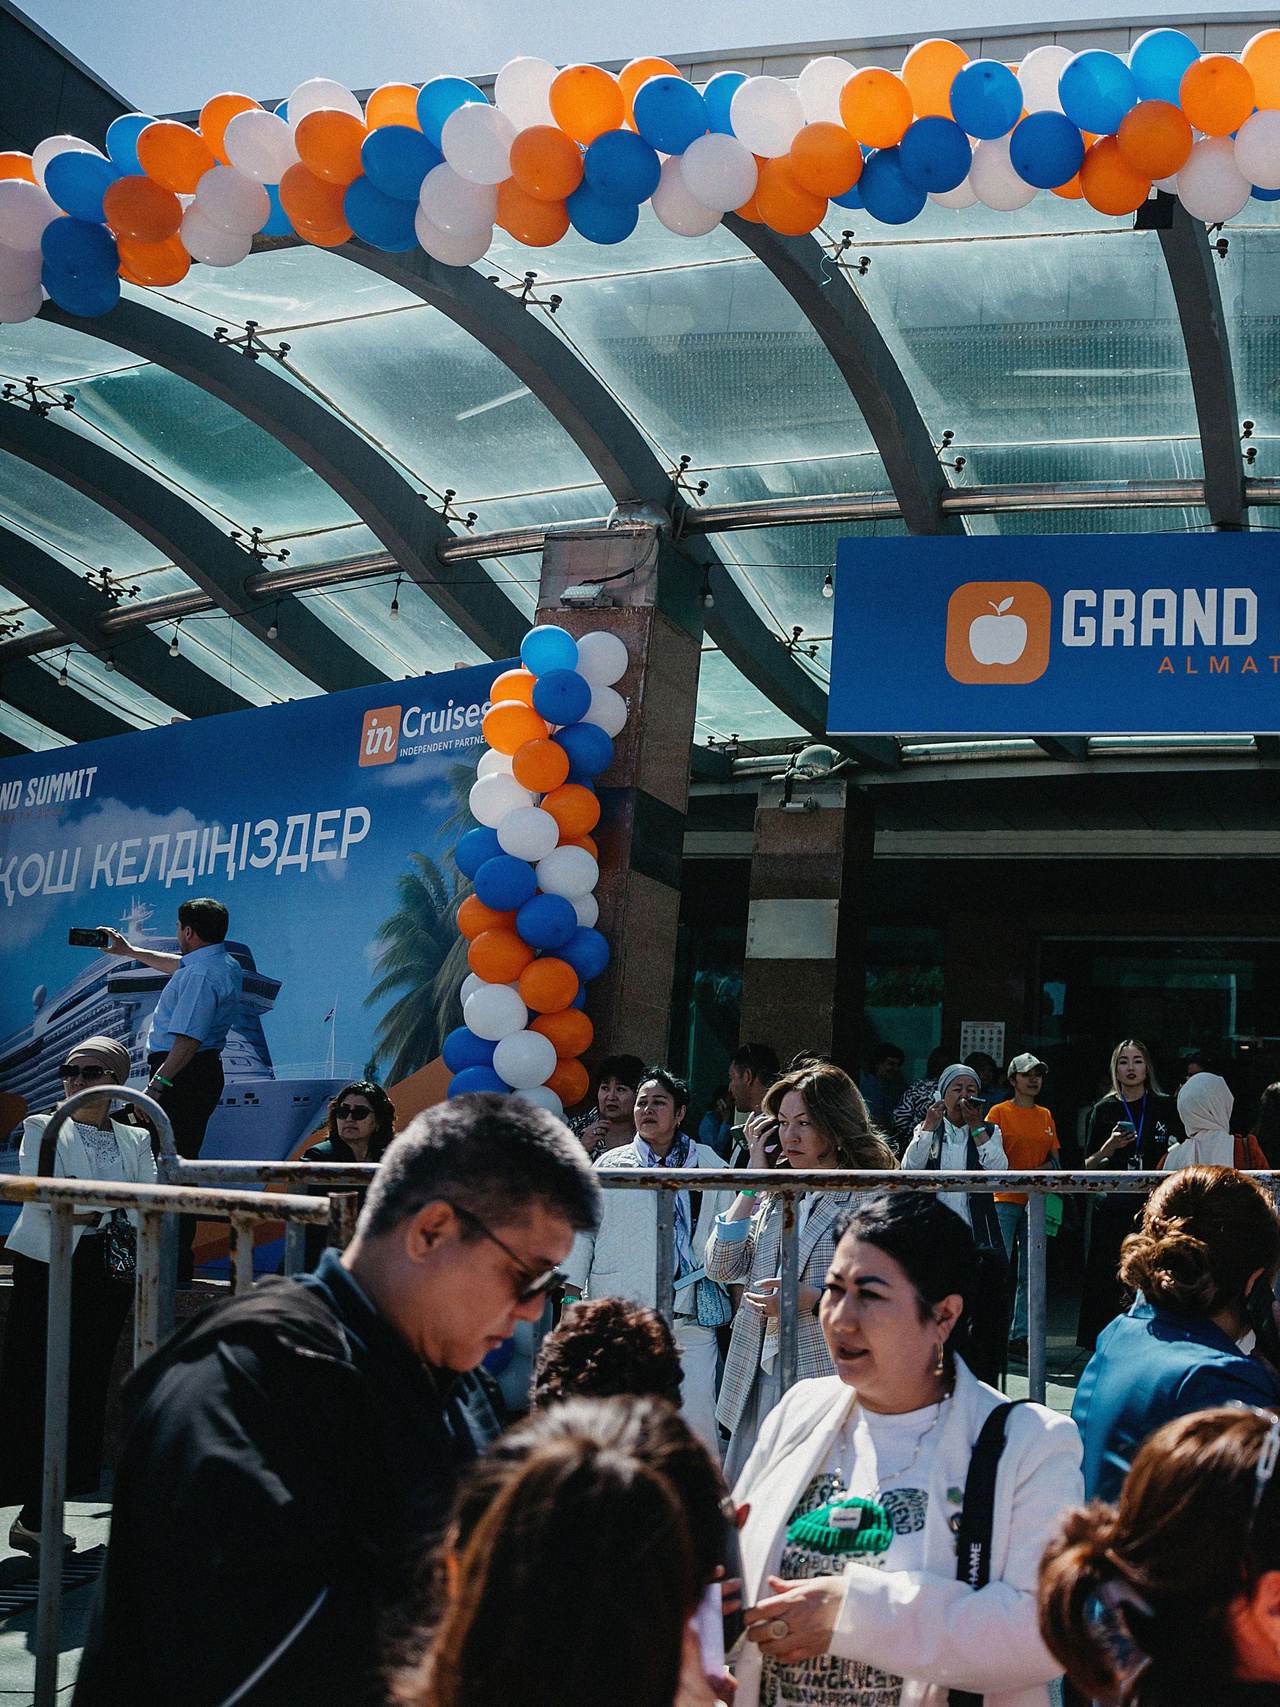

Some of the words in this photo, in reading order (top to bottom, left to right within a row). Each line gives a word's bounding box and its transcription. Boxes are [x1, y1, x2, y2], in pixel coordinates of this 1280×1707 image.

[1062, 587, 1258, 647] GRAND
[365, 718, 396, 756] in
[400, 740, 453, 757] INDEPENDENT
[454, 734, 488, 748] PARTNE
[0, 780, 23, 812] ND
[25, 766, 98, 807] SUMMIT
[90, 806, 371, 890] КЕЛДІҢІЗДЕР
